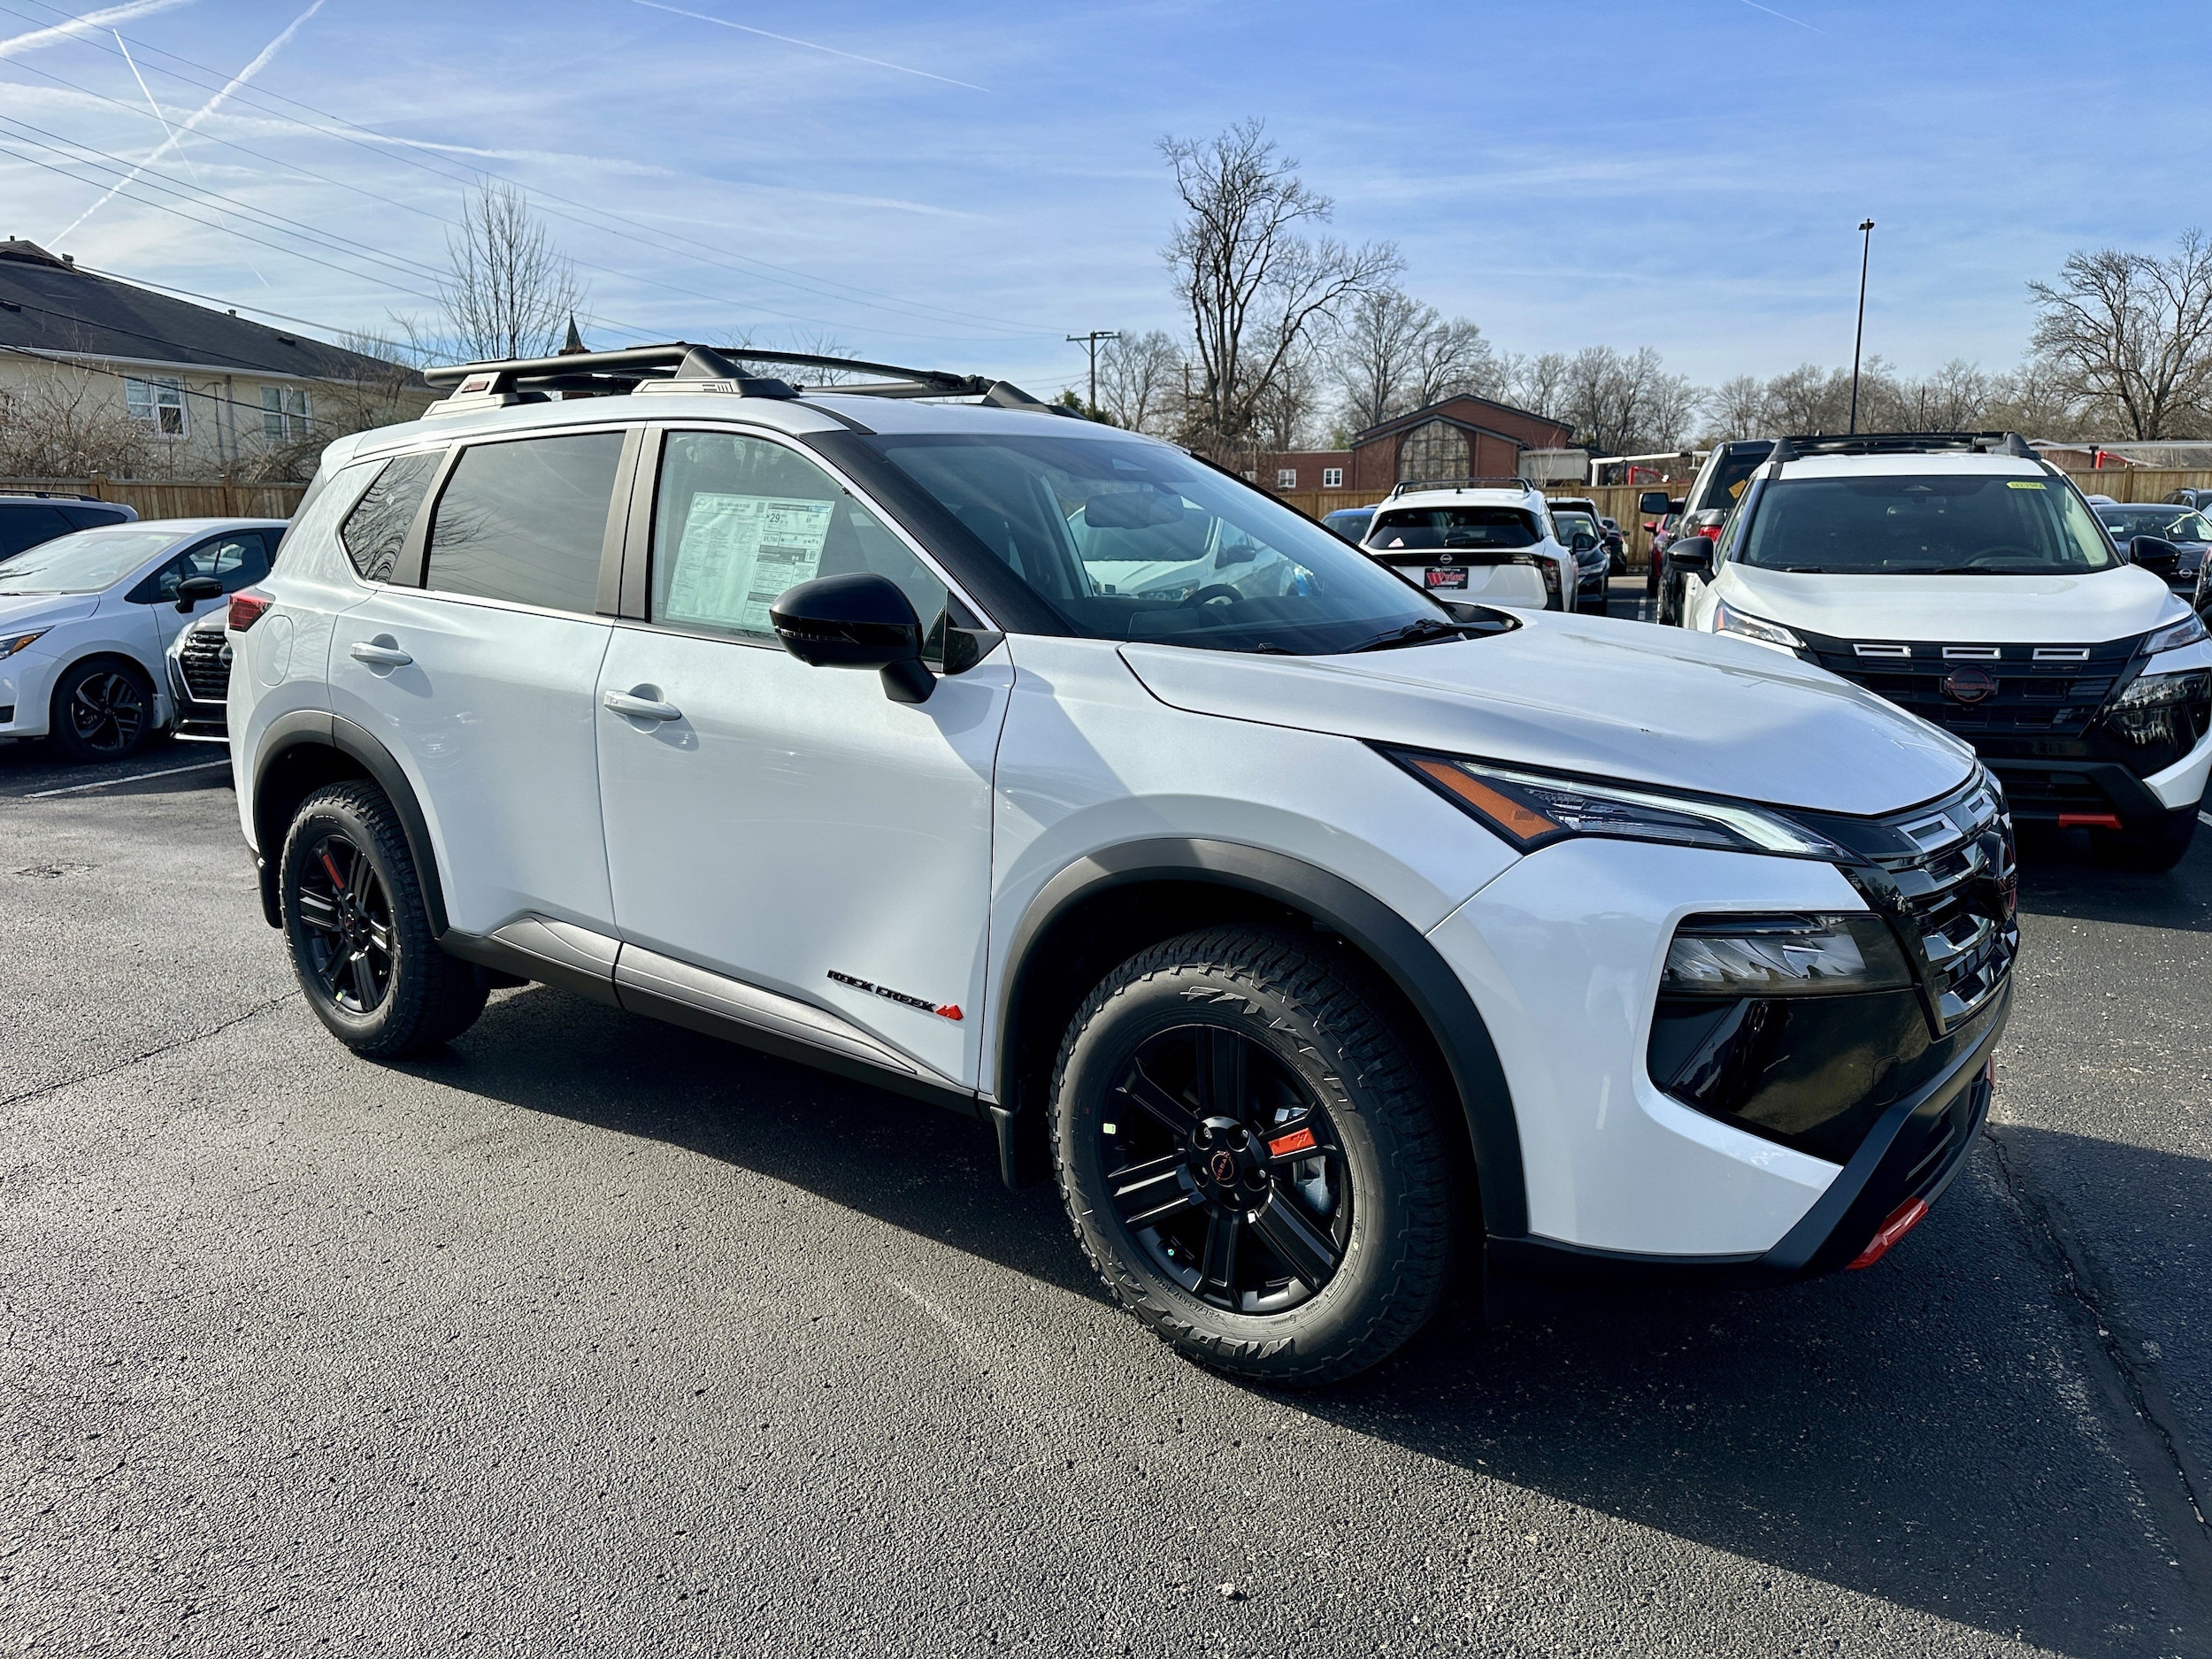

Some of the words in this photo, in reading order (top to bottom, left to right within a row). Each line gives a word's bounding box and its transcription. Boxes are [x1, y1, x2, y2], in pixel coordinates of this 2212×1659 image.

[769, 512, 780, 523] 29
[826, 969, 874, 993] ROCK
[875, 985, 937, 1013] CREEK
[1215, 1152, 1231, 1181] NISSAN
